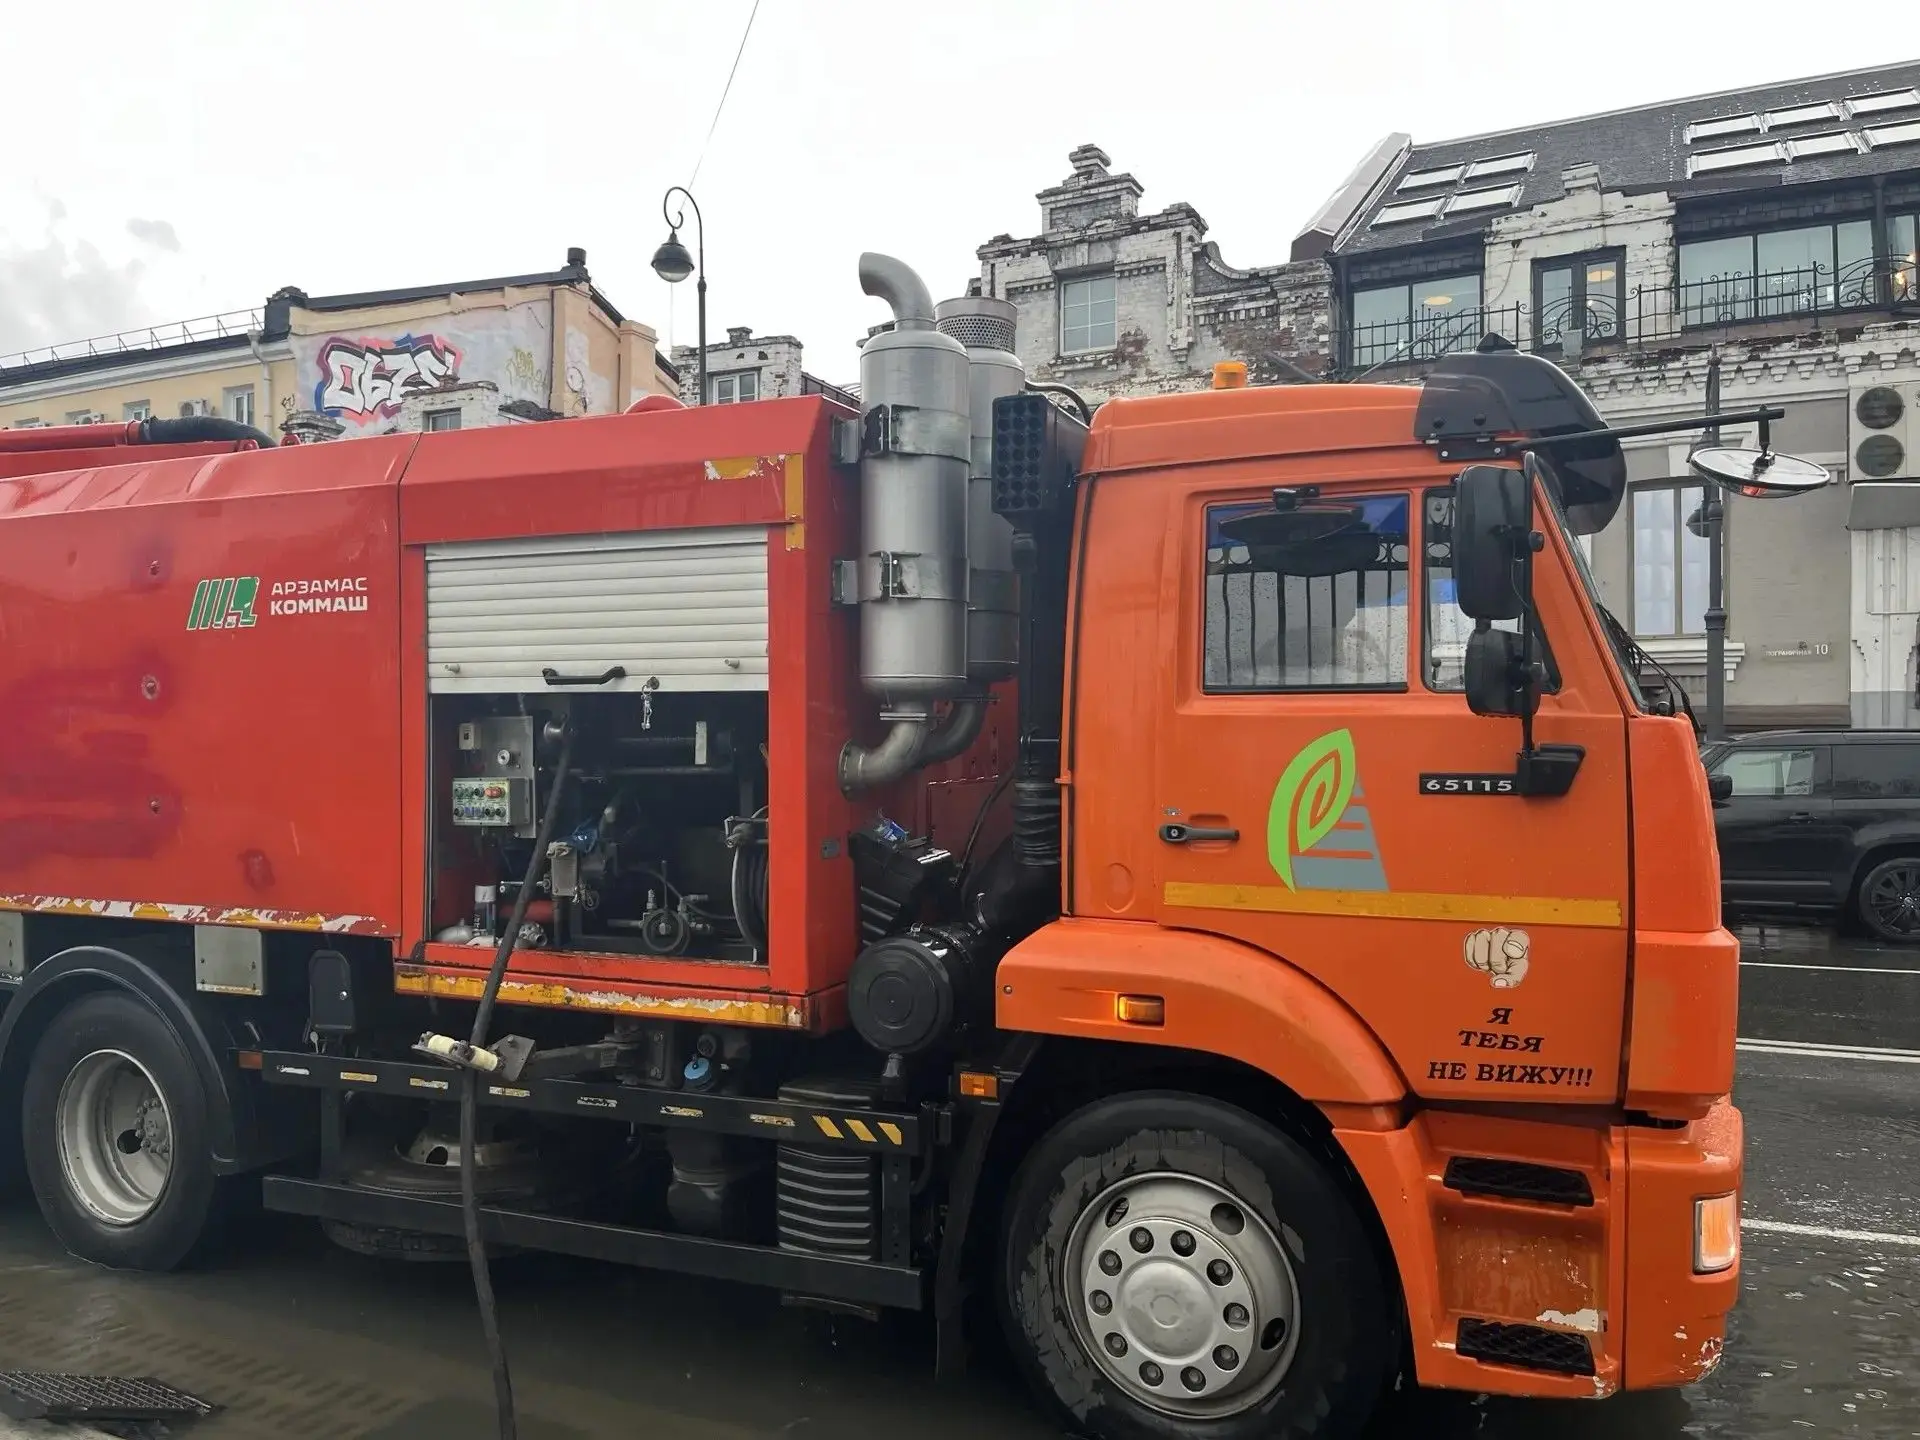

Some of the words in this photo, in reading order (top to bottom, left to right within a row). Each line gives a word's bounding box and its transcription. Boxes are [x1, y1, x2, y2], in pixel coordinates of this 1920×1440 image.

[271, 577, 368, 596] АРЗАМАС
[270, 596, 368, 616] КОММАШ
[1814, 643, 1829, 655] 10
[1426, 779, 1513, 792] 65115
[1486, 1007, 1514, 1025] Я
[1458, 1030, 1545, 1053] ТЕБЯ
[1426, 1061, 1467, 1081] НЕ
[1475, 1063, 1594, 1088] ВИЖУ!!!
